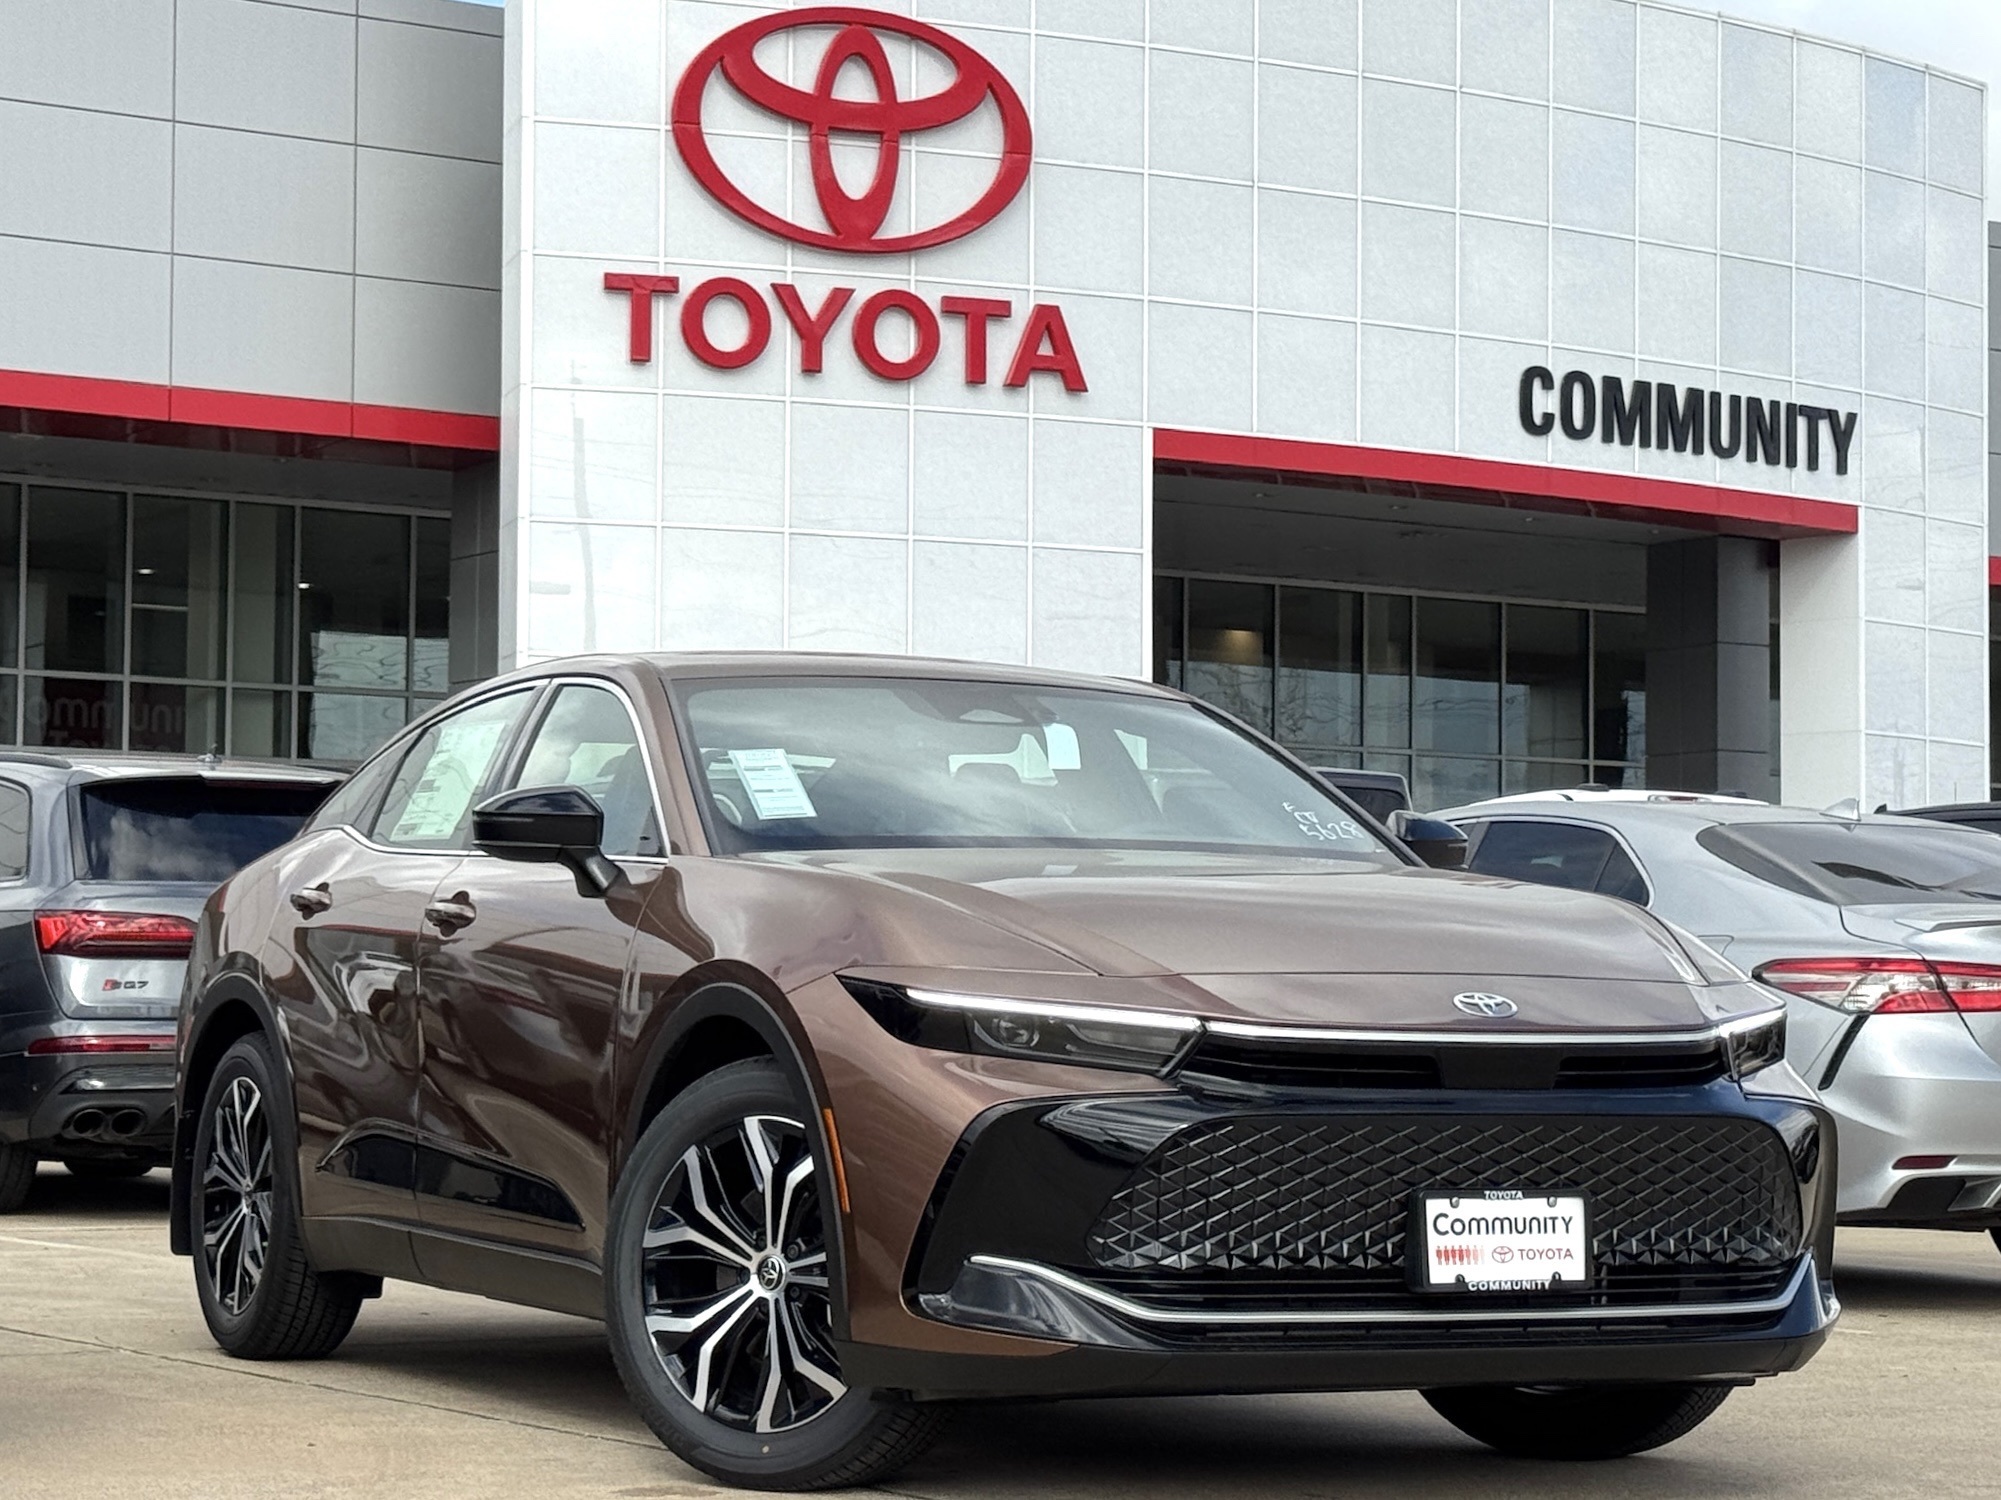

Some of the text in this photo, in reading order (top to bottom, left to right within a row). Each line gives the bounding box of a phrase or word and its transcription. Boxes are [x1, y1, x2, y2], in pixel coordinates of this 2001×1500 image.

[604, 272, 1088, 393] TOYOTA
[1519, 365, 1858, 476] COMMUNITY
[1483, 1190, 1525, 1200] TOYOTA
[1517, 1248, 1574, 1261] TOYOTA
[1467, 1280, 1551, 1292] COMMUNITY
